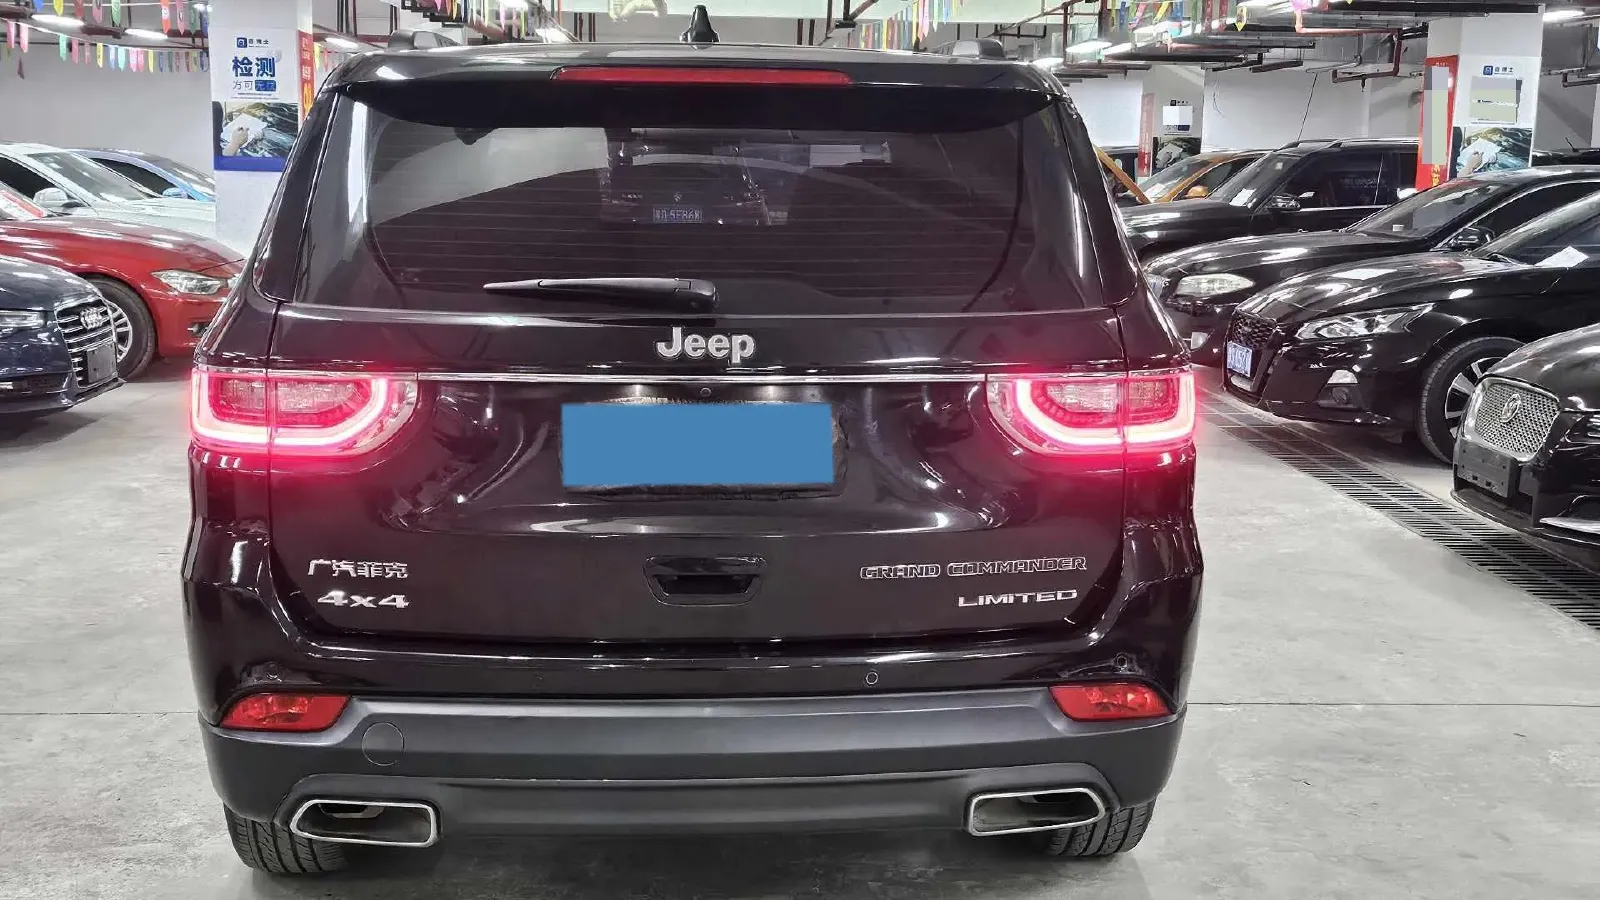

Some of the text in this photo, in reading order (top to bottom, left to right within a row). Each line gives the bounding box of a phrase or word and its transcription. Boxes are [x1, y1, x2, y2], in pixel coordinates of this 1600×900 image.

[232, 56, 276, 78] 检测
[657, 326, 755, 363] Jeep
[307, 559, 408, 578] 广汽菲克
[860, 557, 1087, 579] GRAND COMMANDER
[317, 590, 410, 609] 4x4
[958, 589, 1078, 607] LIMITED
